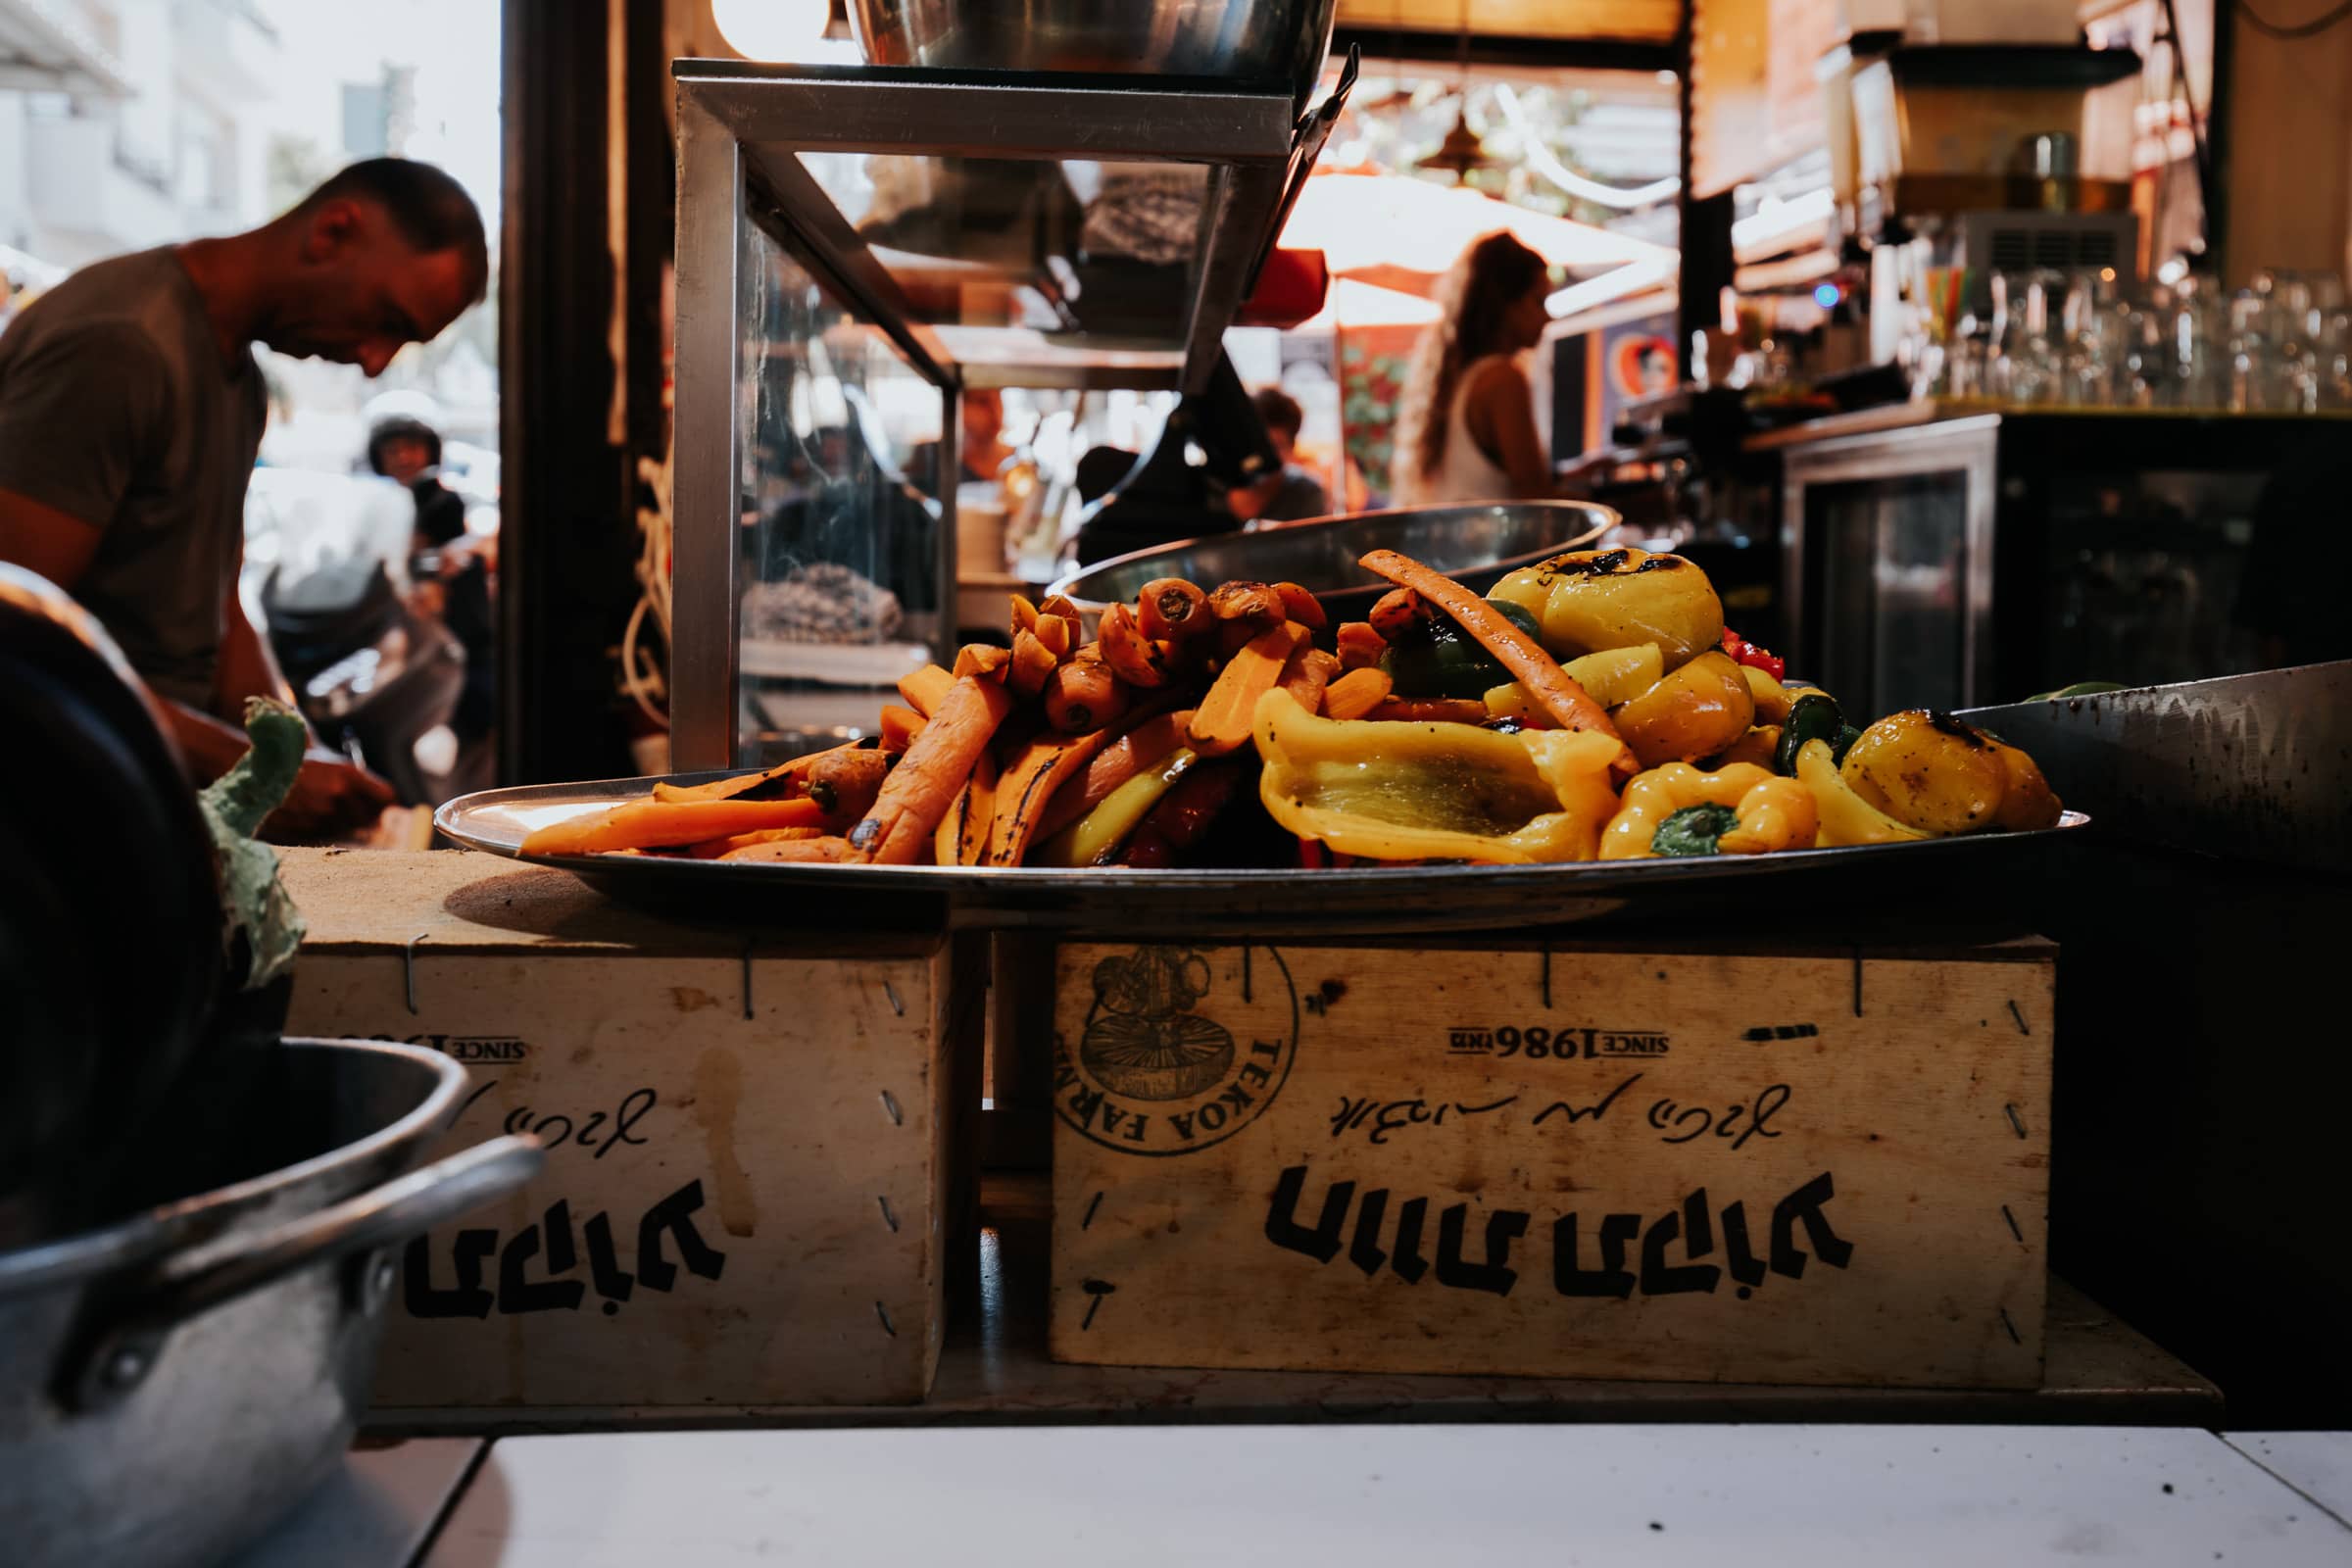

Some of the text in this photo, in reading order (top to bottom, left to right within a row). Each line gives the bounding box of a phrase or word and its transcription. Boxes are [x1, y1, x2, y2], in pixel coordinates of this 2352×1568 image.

[452, 1042, 525, 1059] SINCE
[1448, 1031, 1494, 1051] מאז
[1495, 1025, 1670, 1059] SINCE 1986
[1168, 1039, 1282, 1141] TEKOA
[1330, 1073, 1792, 1152] אוצרות מן הטבע
[1264, 1164, 1532, 1296] חוות
